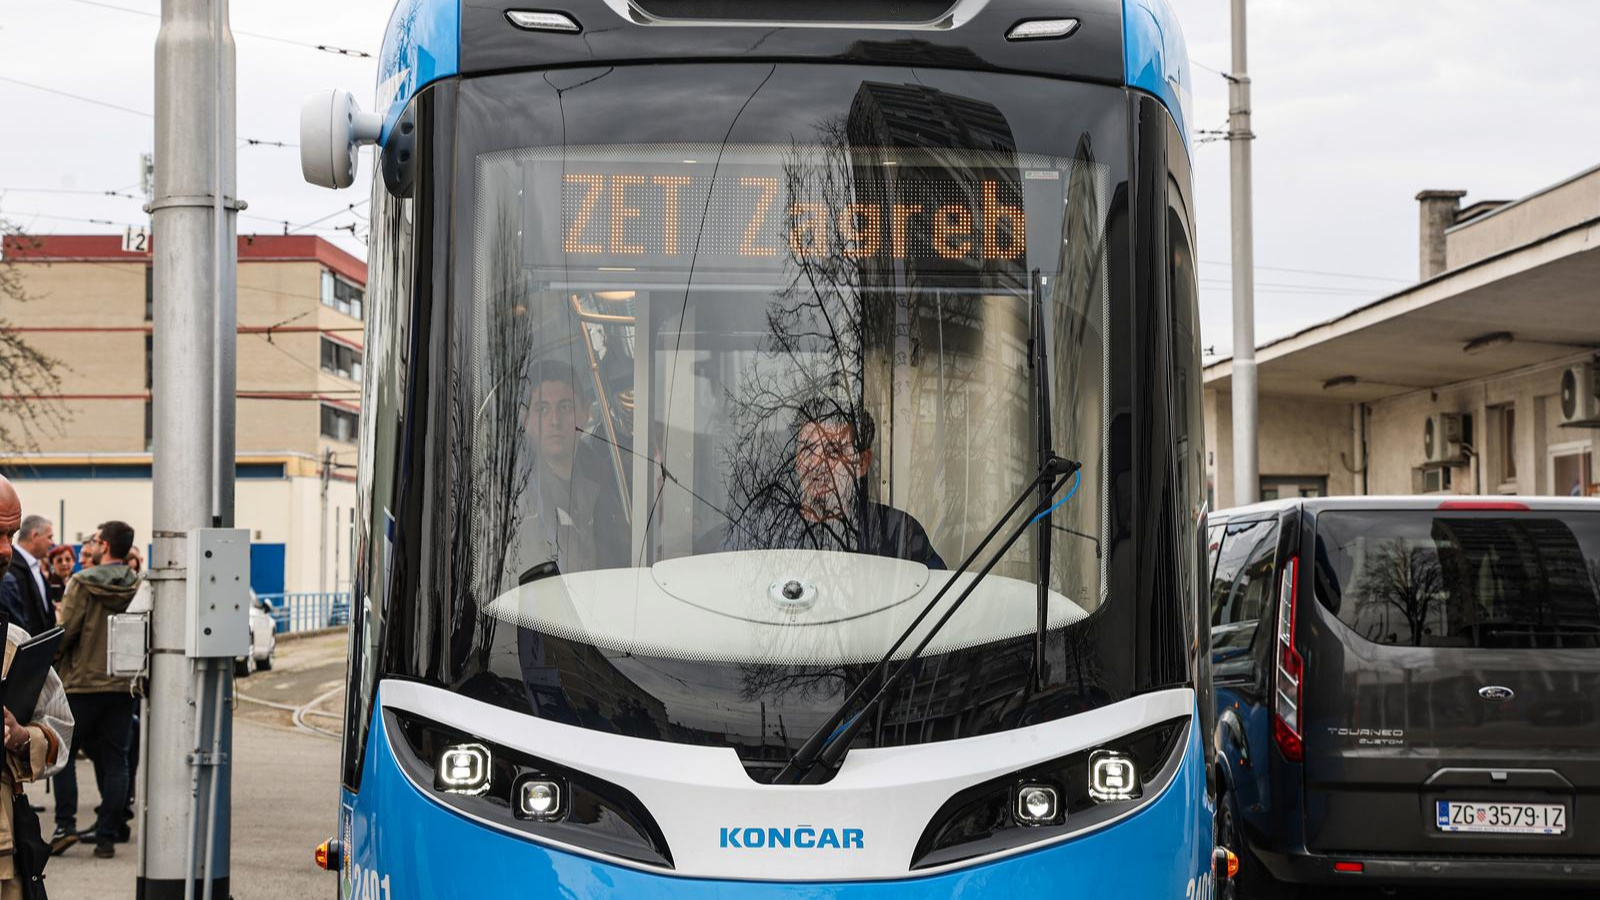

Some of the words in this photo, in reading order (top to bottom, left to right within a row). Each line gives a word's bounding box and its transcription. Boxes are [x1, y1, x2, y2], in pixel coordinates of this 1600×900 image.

[564, 173, 692, 254] ZET
[740, 176, 1026, 259] Zagreb
[1327, 727, 1404, 737] TOURNEO
[1451, 804, 1475, 825] ZG
